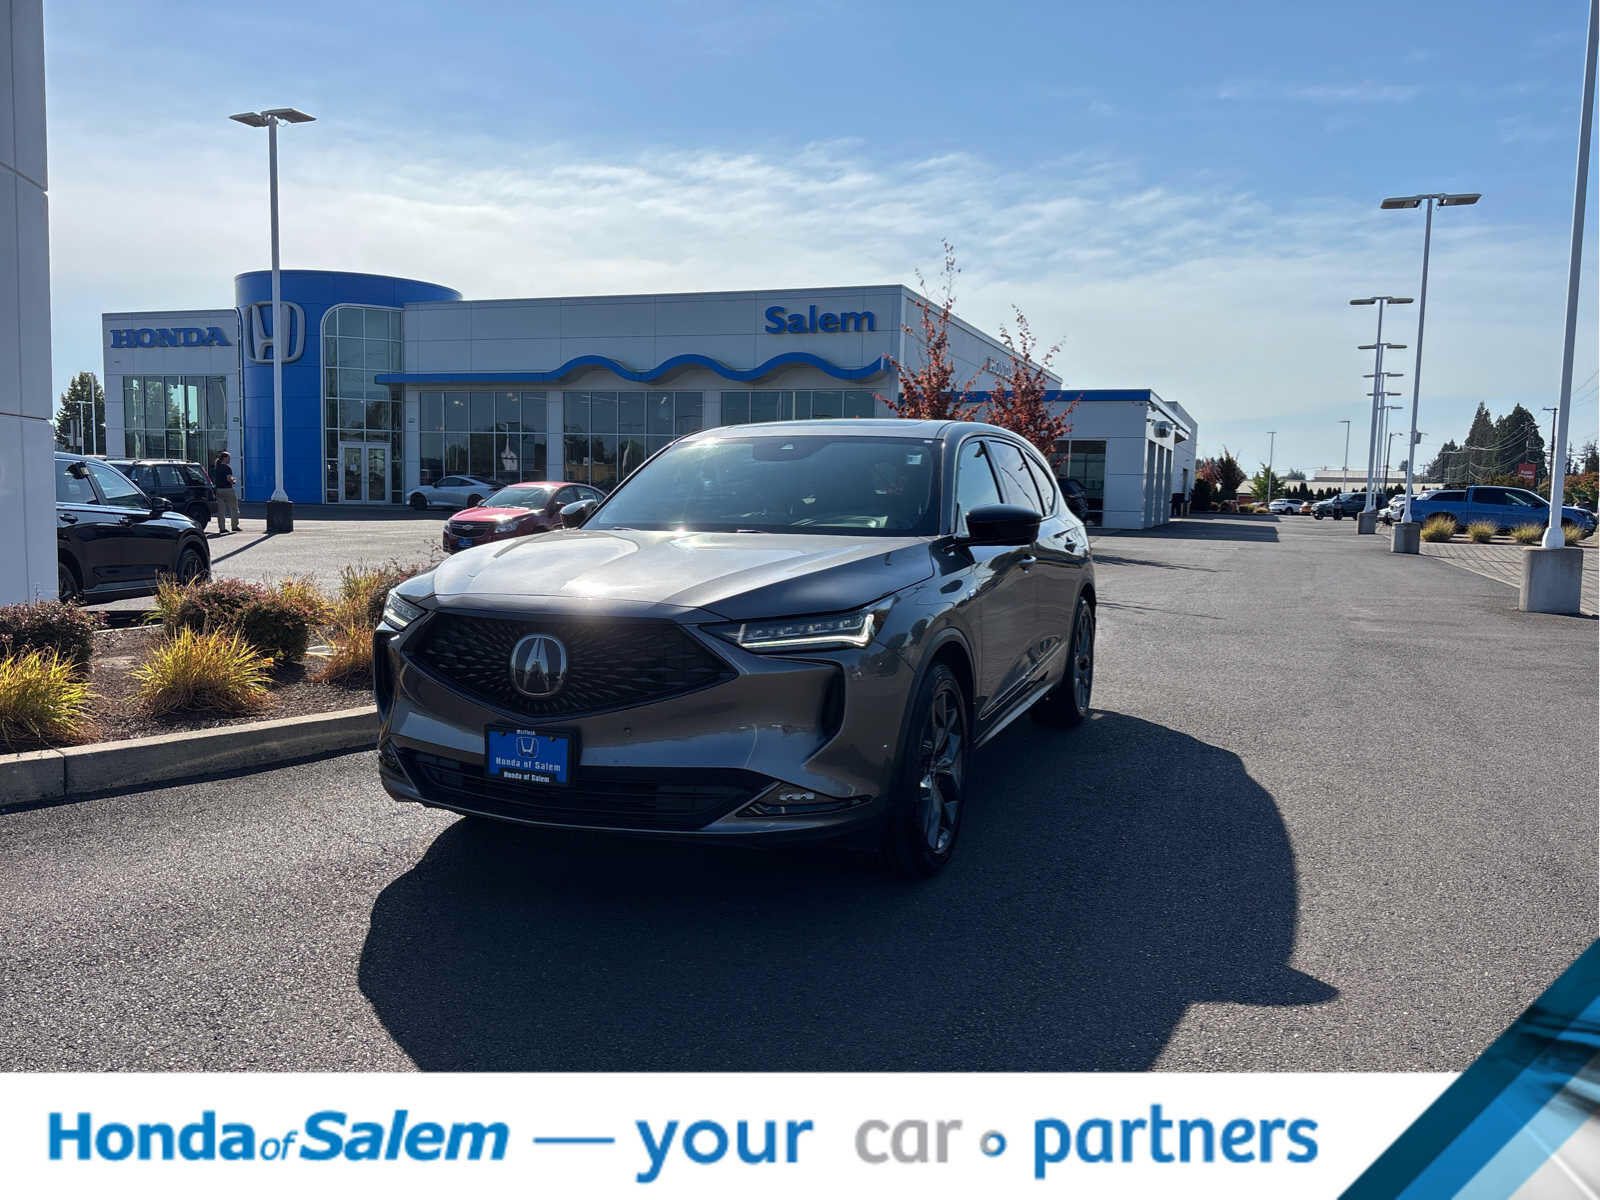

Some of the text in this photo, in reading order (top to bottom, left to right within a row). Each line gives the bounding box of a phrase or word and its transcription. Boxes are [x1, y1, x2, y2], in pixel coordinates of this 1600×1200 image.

[764, 304, 875, 334] Salem
[110, 326, 232, 348] HONDA
[495, 757, 520, 767] Honda
[534, 761, 561, 772] Salem
[503, 771, 522, 780] Honda
[531, 774, 550, 783] Salem
